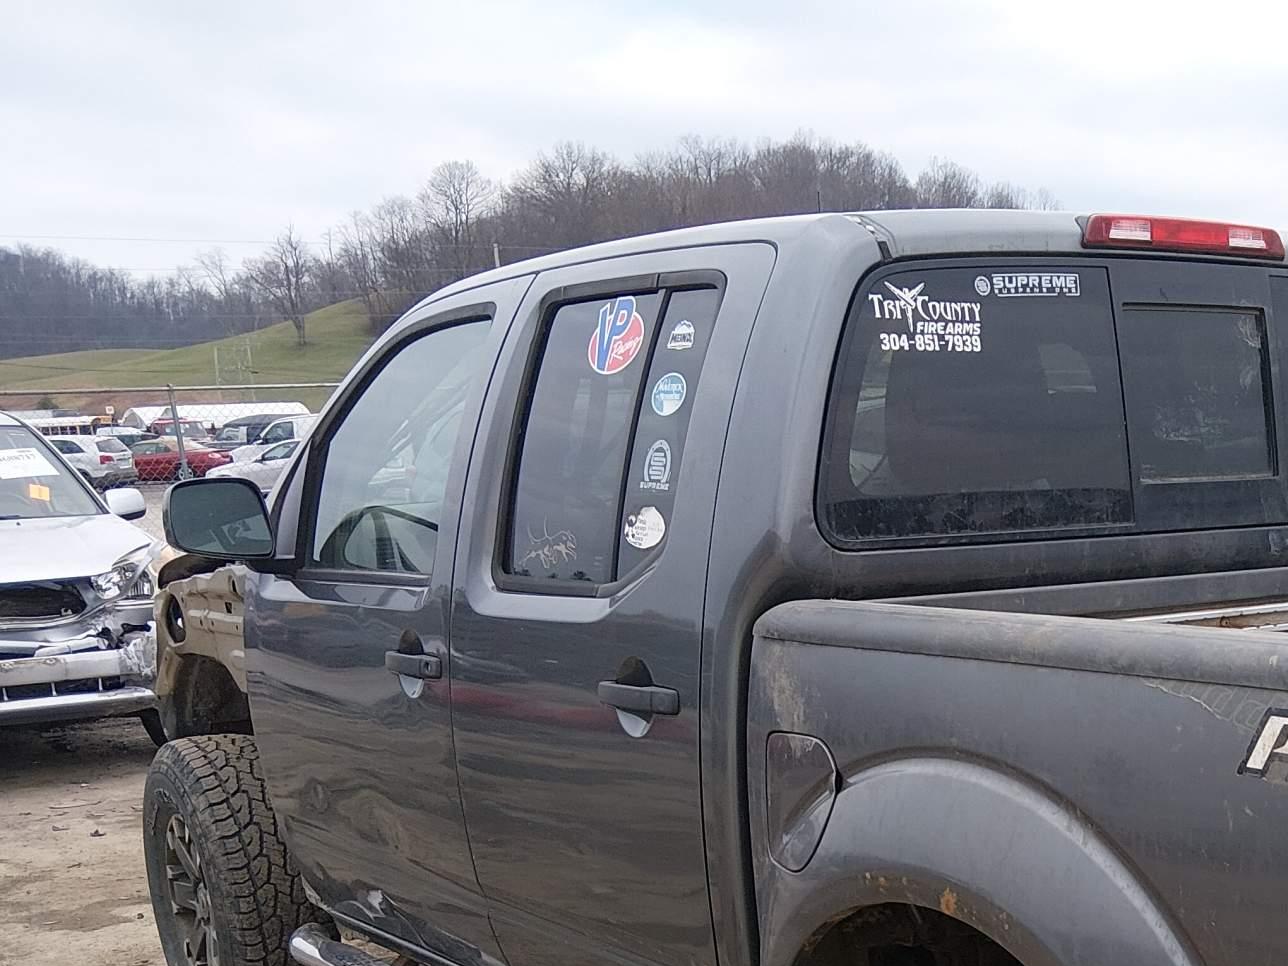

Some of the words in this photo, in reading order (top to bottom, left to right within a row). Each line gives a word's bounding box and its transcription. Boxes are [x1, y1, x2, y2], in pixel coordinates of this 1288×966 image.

[993, 276, 1076, 288] SUPREME
[868, 293, 903, 320] TRI
[917, 296, 981, 322] COUNTY
[596, 295, 637, 372] VP
[916, 321, 981, 336] FIREARMS
[879, 333, 982, 352] 304-851-7939
